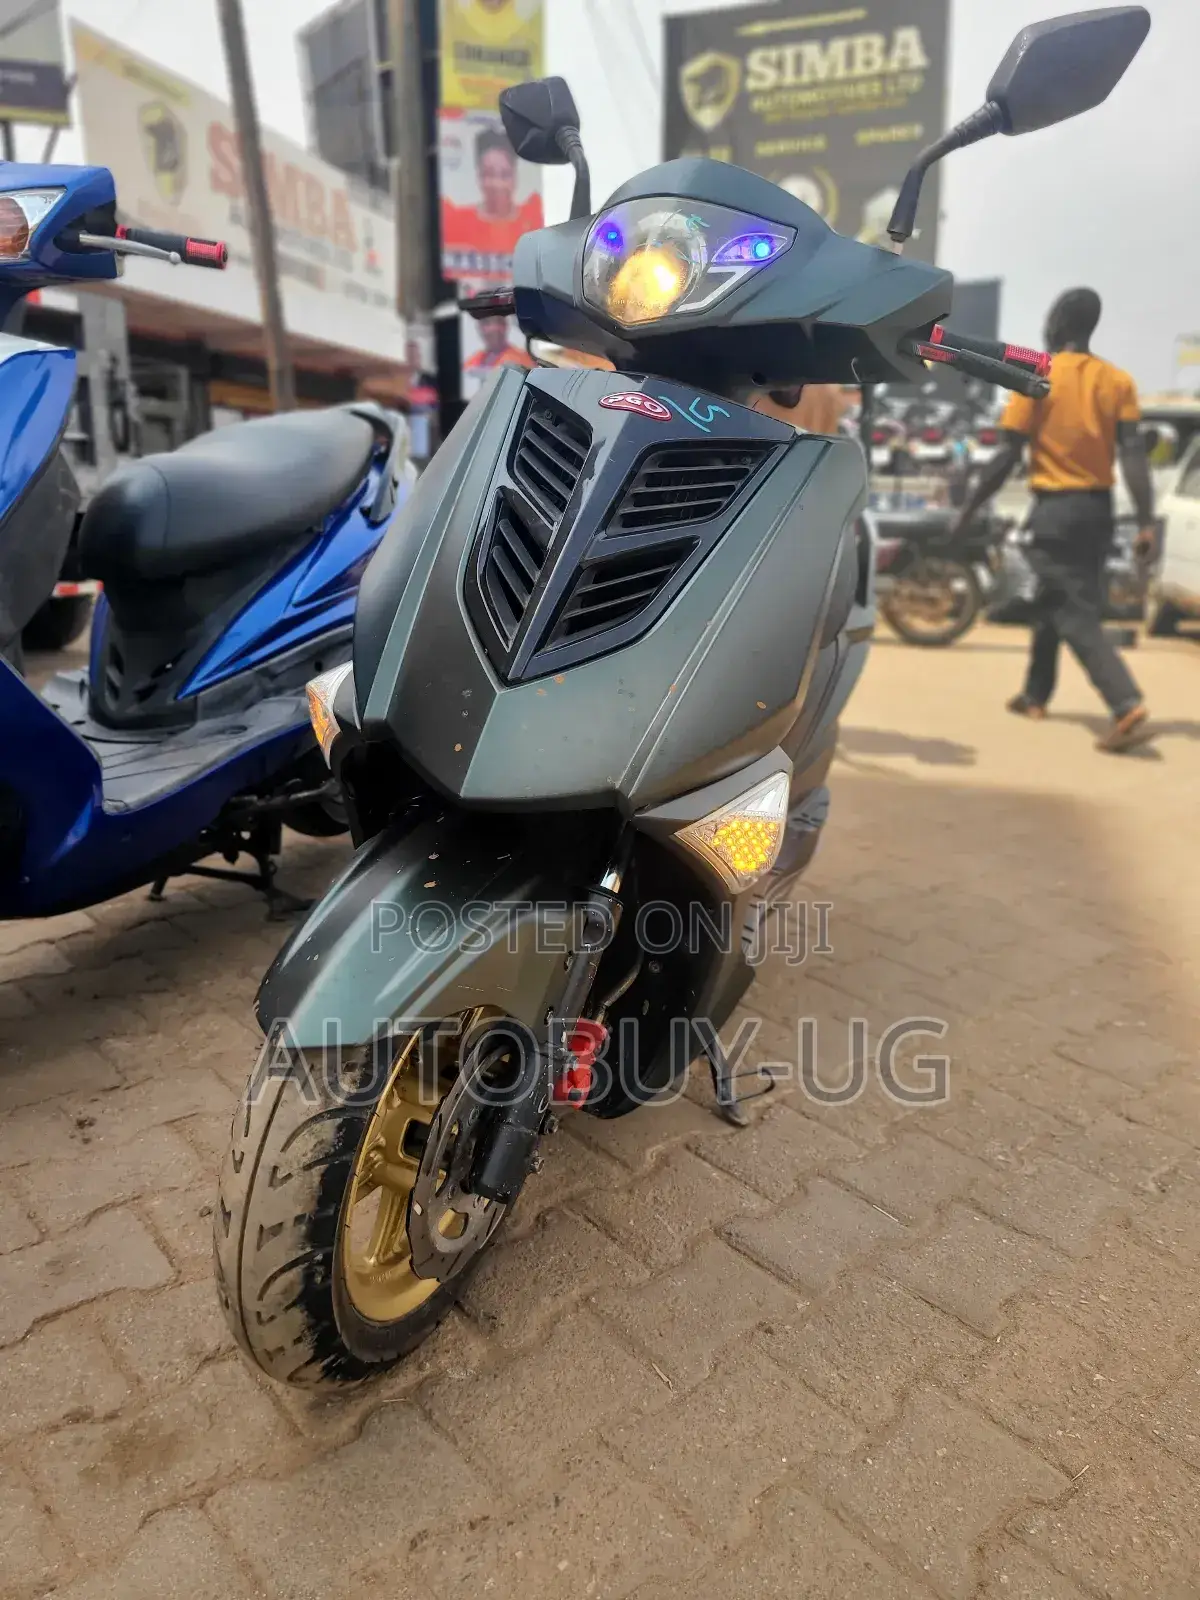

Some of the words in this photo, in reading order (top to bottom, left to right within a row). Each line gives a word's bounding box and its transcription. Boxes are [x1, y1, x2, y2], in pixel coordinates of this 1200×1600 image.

[745, 25, 930, 90] SIMBA
[206, 120, 358, 254] SMBA
[608, 395, 664, 413] PGO
